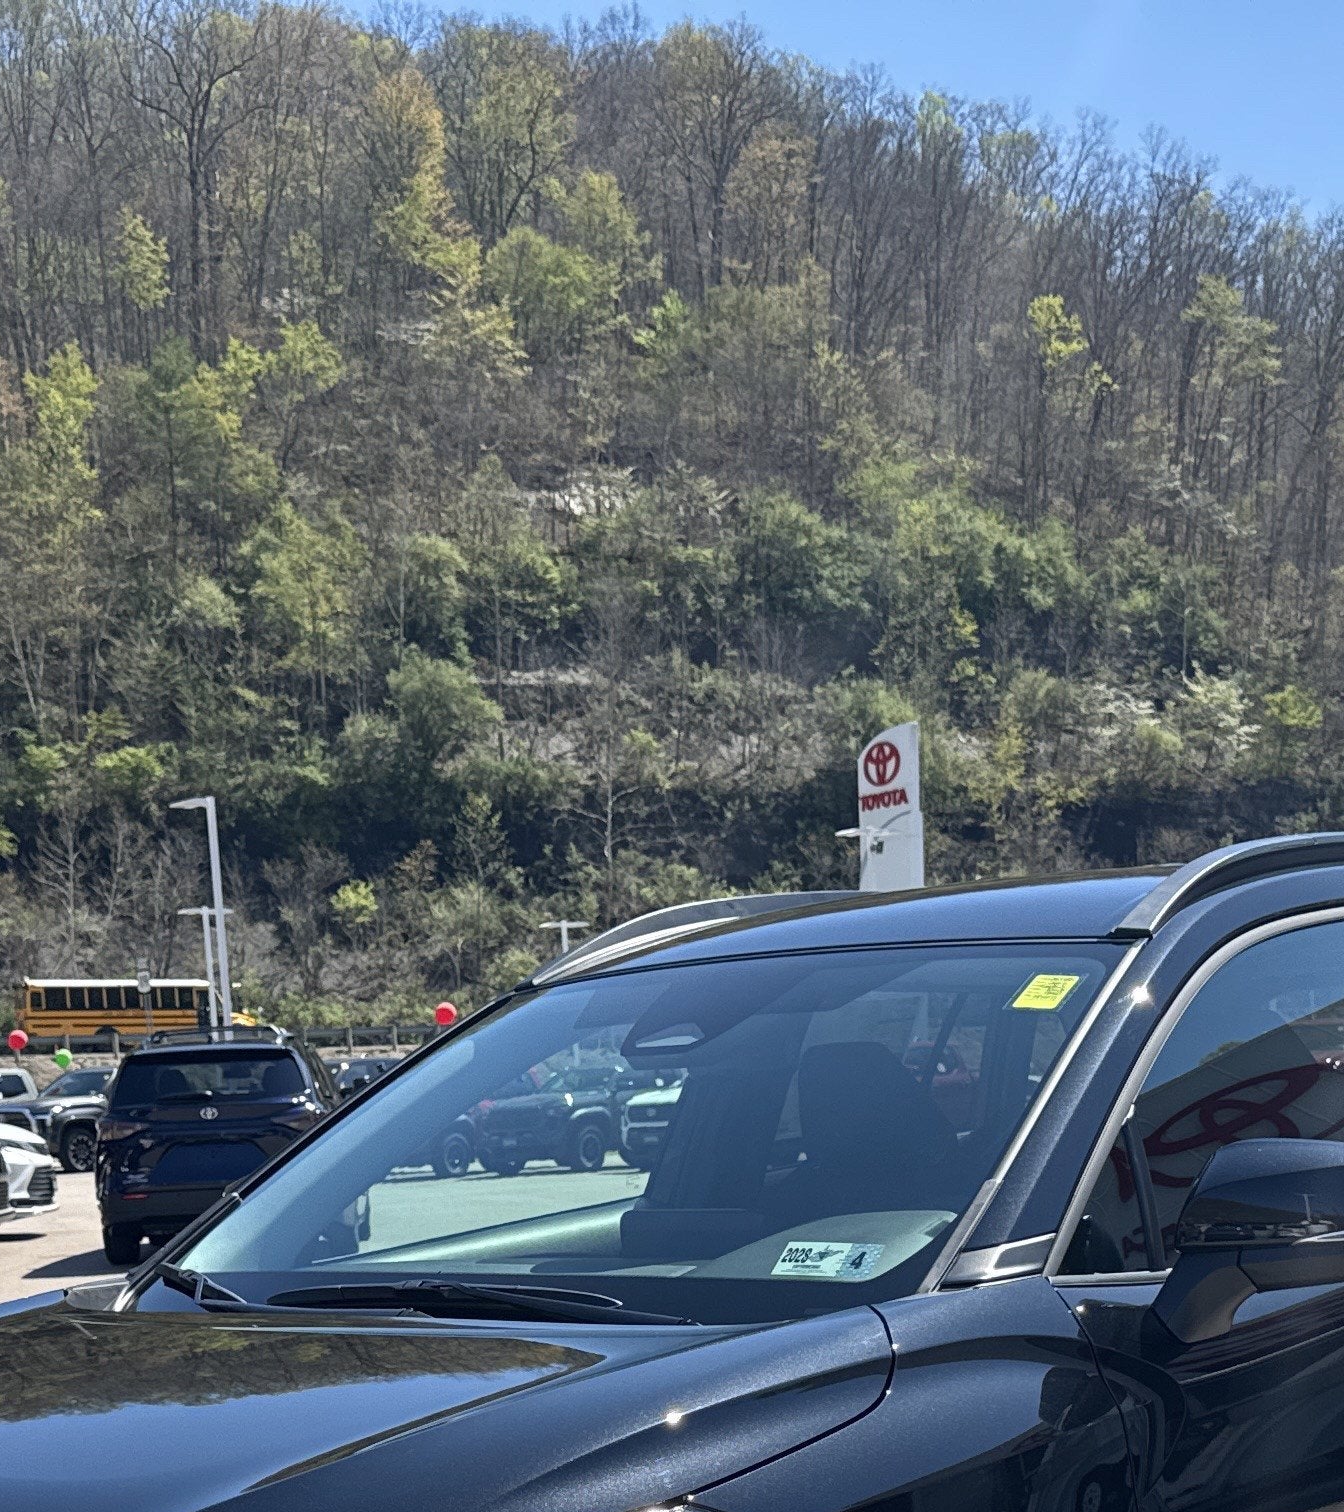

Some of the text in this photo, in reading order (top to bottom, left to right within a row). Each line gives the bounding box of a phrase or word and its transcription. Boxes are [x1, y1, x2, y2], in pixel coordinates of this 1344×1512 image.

[860, 789, 909, 812] TOYOTA
[781, 1247, 813, 1263] 2028
[850, 1251, 867, 1269] 4
